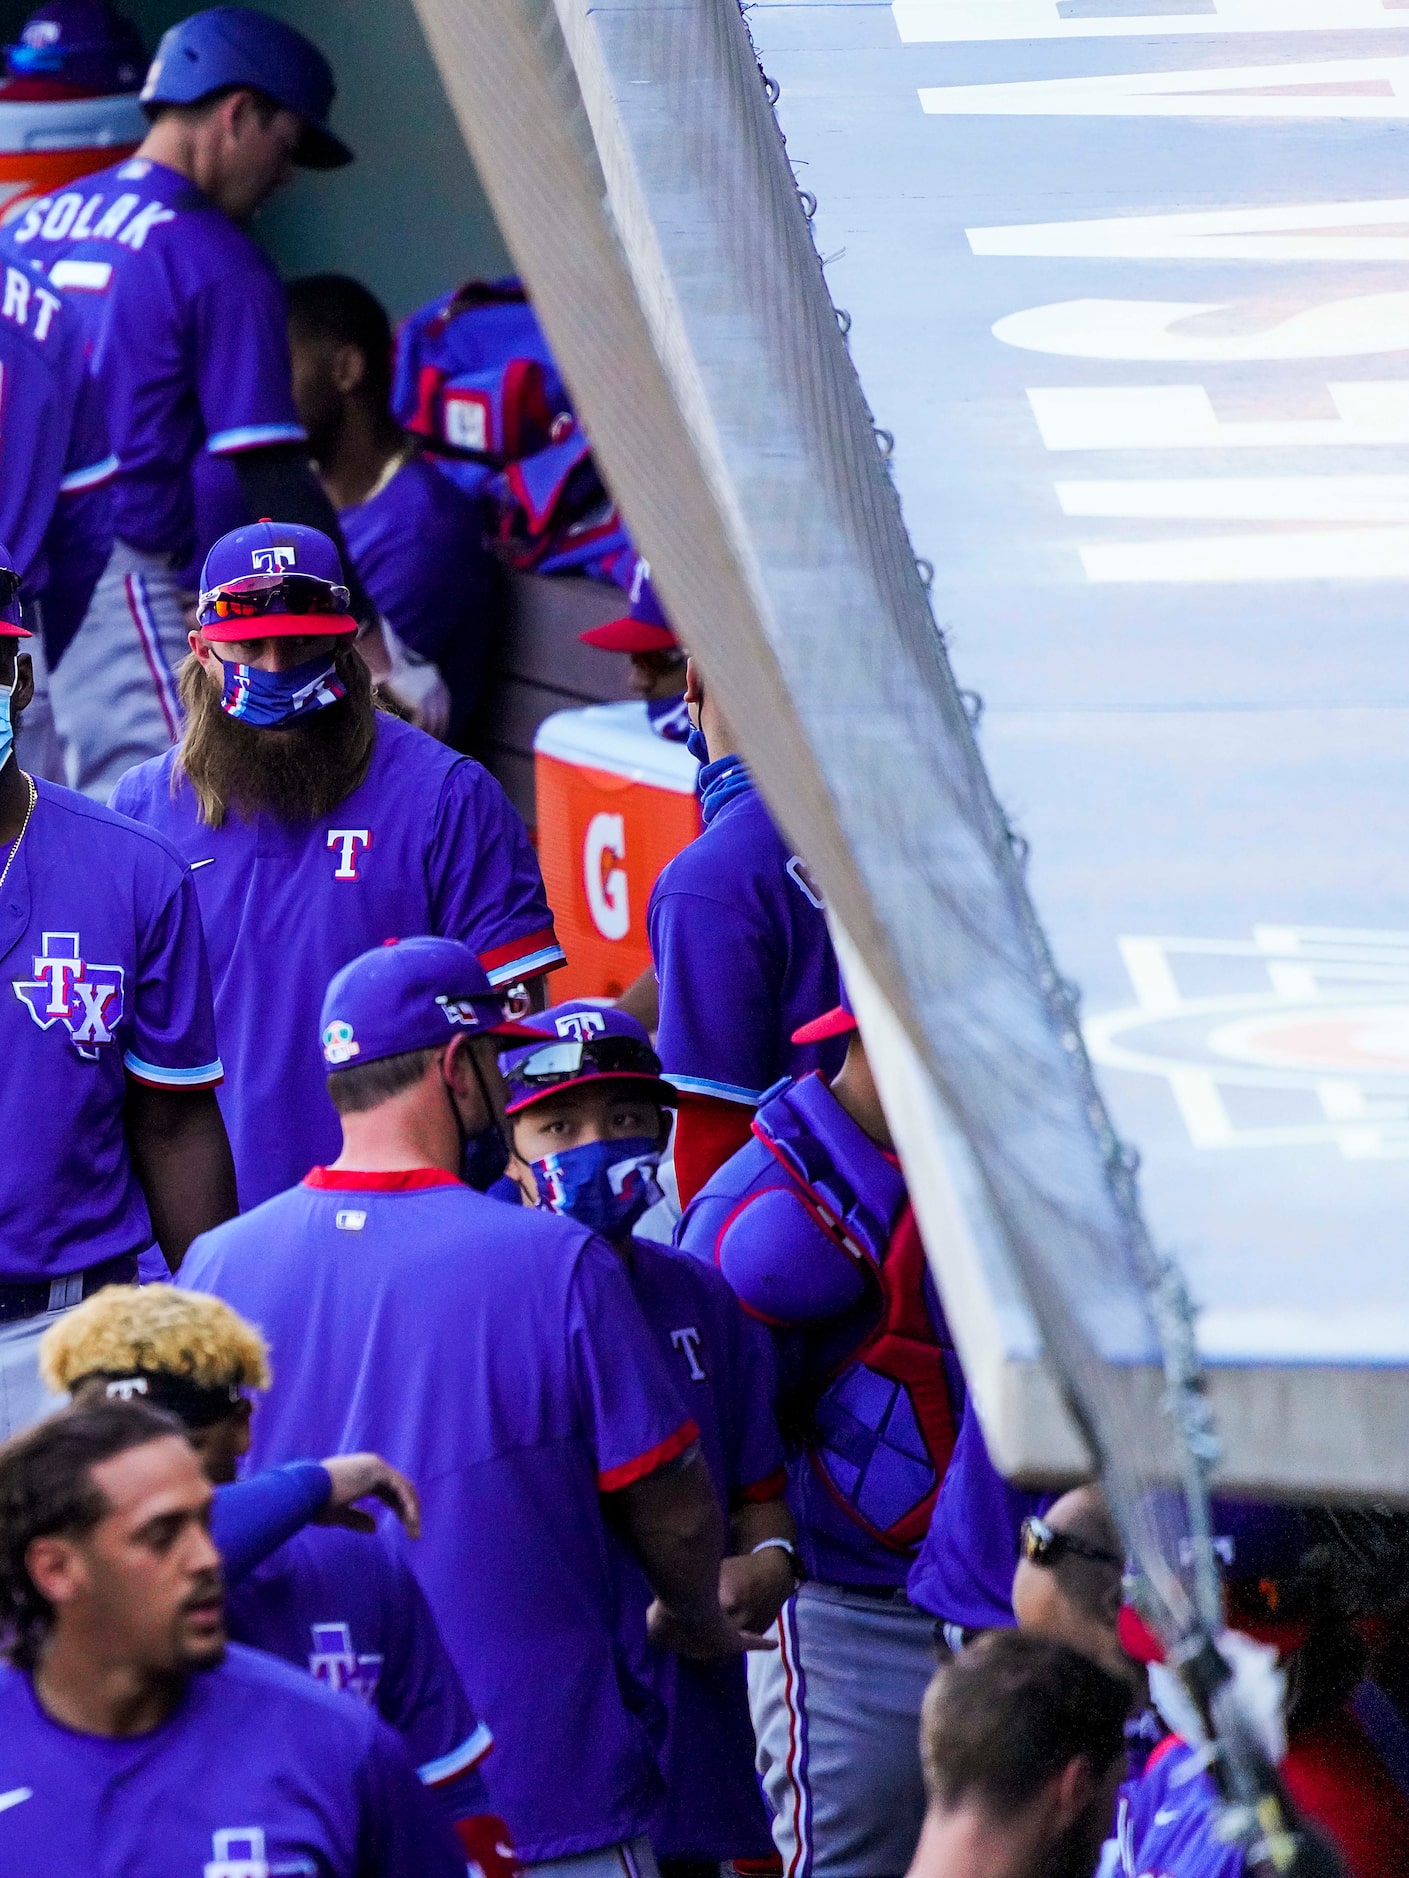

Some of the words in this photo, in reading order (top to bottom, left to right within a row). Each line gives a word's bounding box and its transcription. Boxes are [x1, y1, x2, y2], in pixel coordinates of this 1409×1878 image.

[14, 191, 177, 251] SOLAK
[326, 828, 372, 881] T
[584, 813, 630, 941] G
[670, 1326, 706, 1381] T
